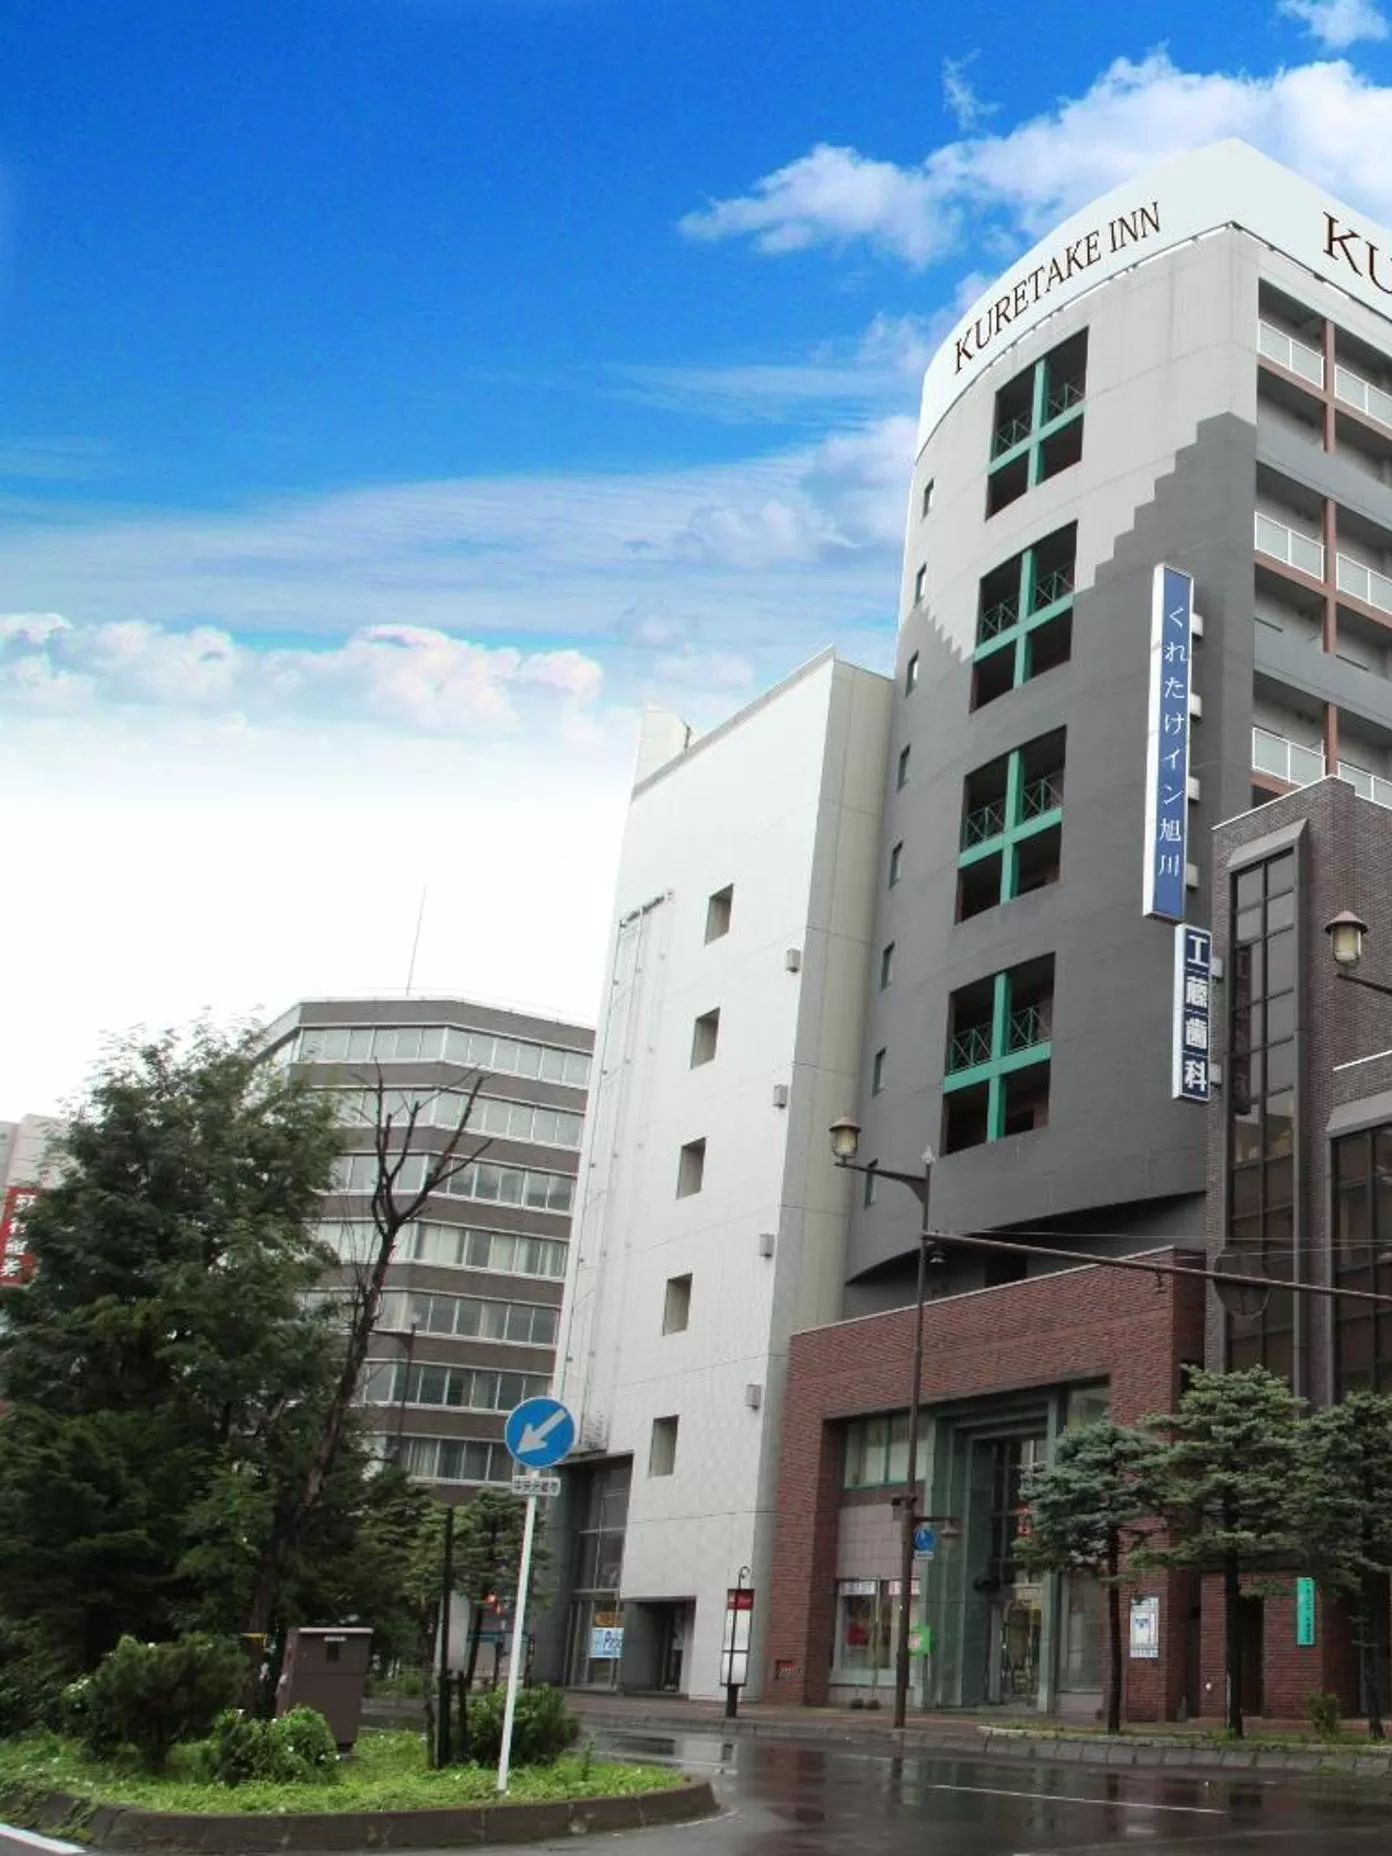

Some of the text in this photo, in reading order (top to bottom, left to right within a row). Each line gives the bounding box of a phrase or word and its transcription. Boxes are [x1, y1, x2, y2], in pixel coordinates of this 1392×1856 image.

[955, 201, 1161, 375] KURETAKE INN
[1157, 605, 1188, 878] くれたけイン旭川
